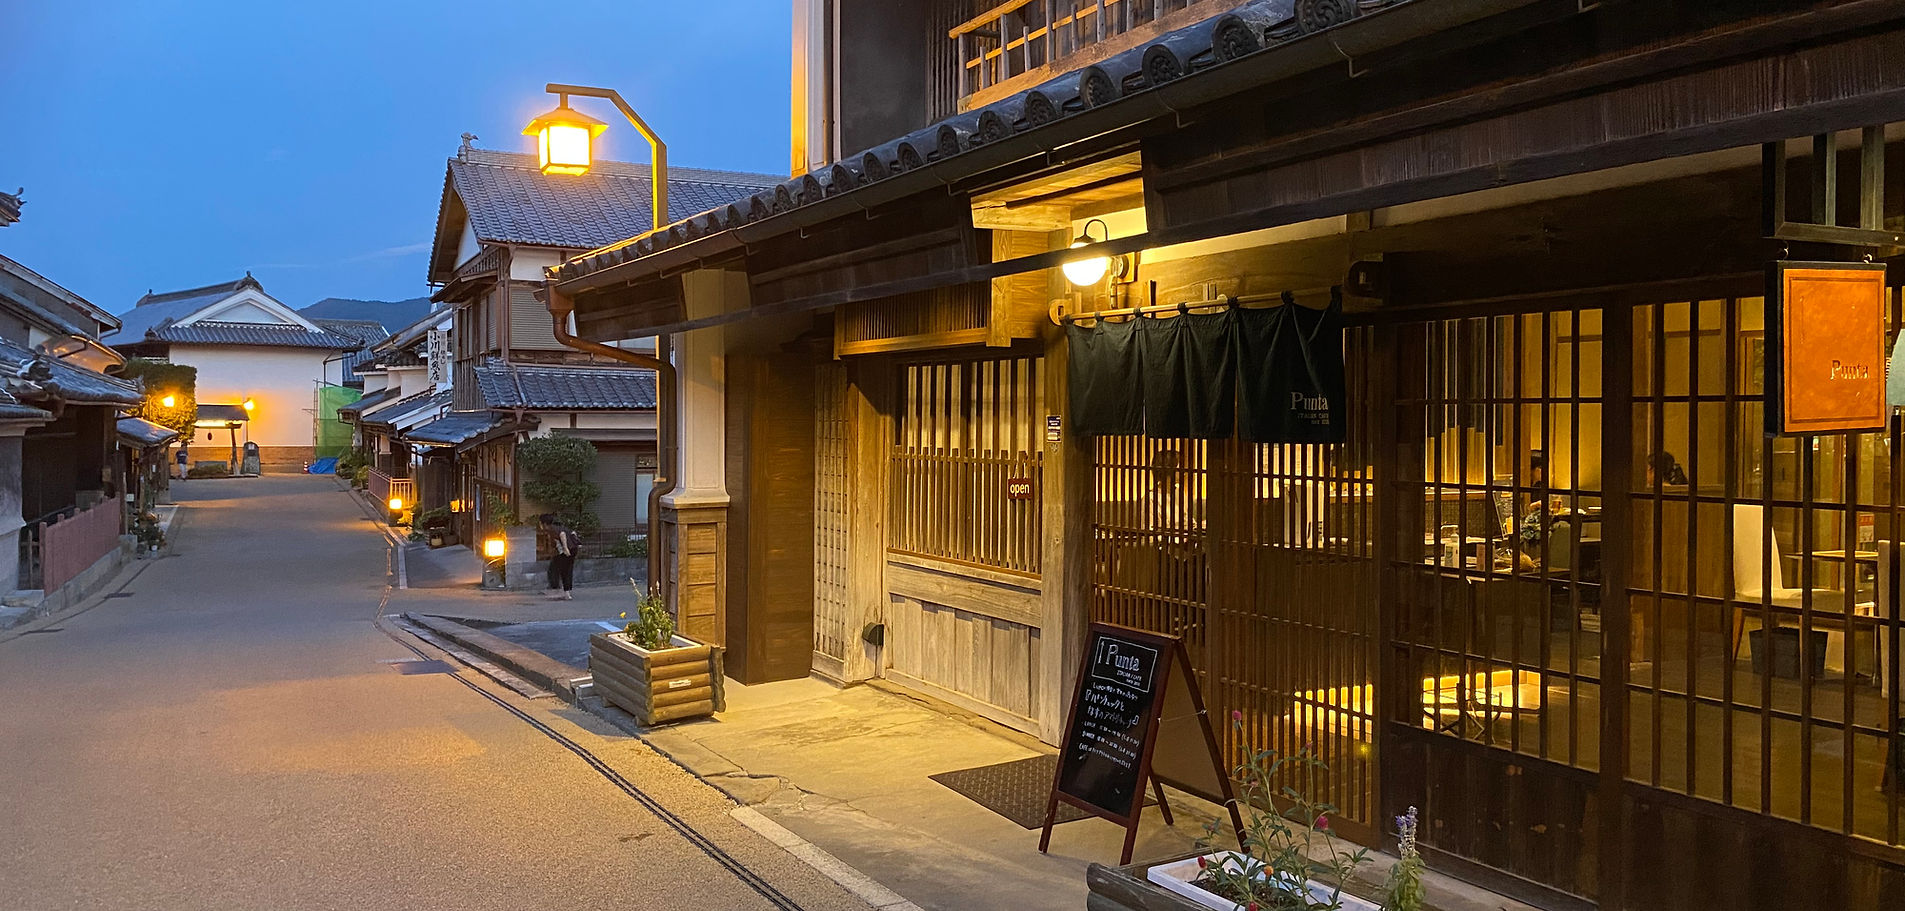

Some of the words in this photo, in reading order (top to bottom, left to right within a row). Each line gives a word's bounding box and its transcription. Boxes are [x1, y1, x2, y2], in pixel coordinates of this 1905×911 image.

[1830, 360, 1869, 380] Punta
[1290, 391, 1329, 411] Punta
[1009, 483, 1030, 497] open
[1105, 644, 1140, 672] Punta
